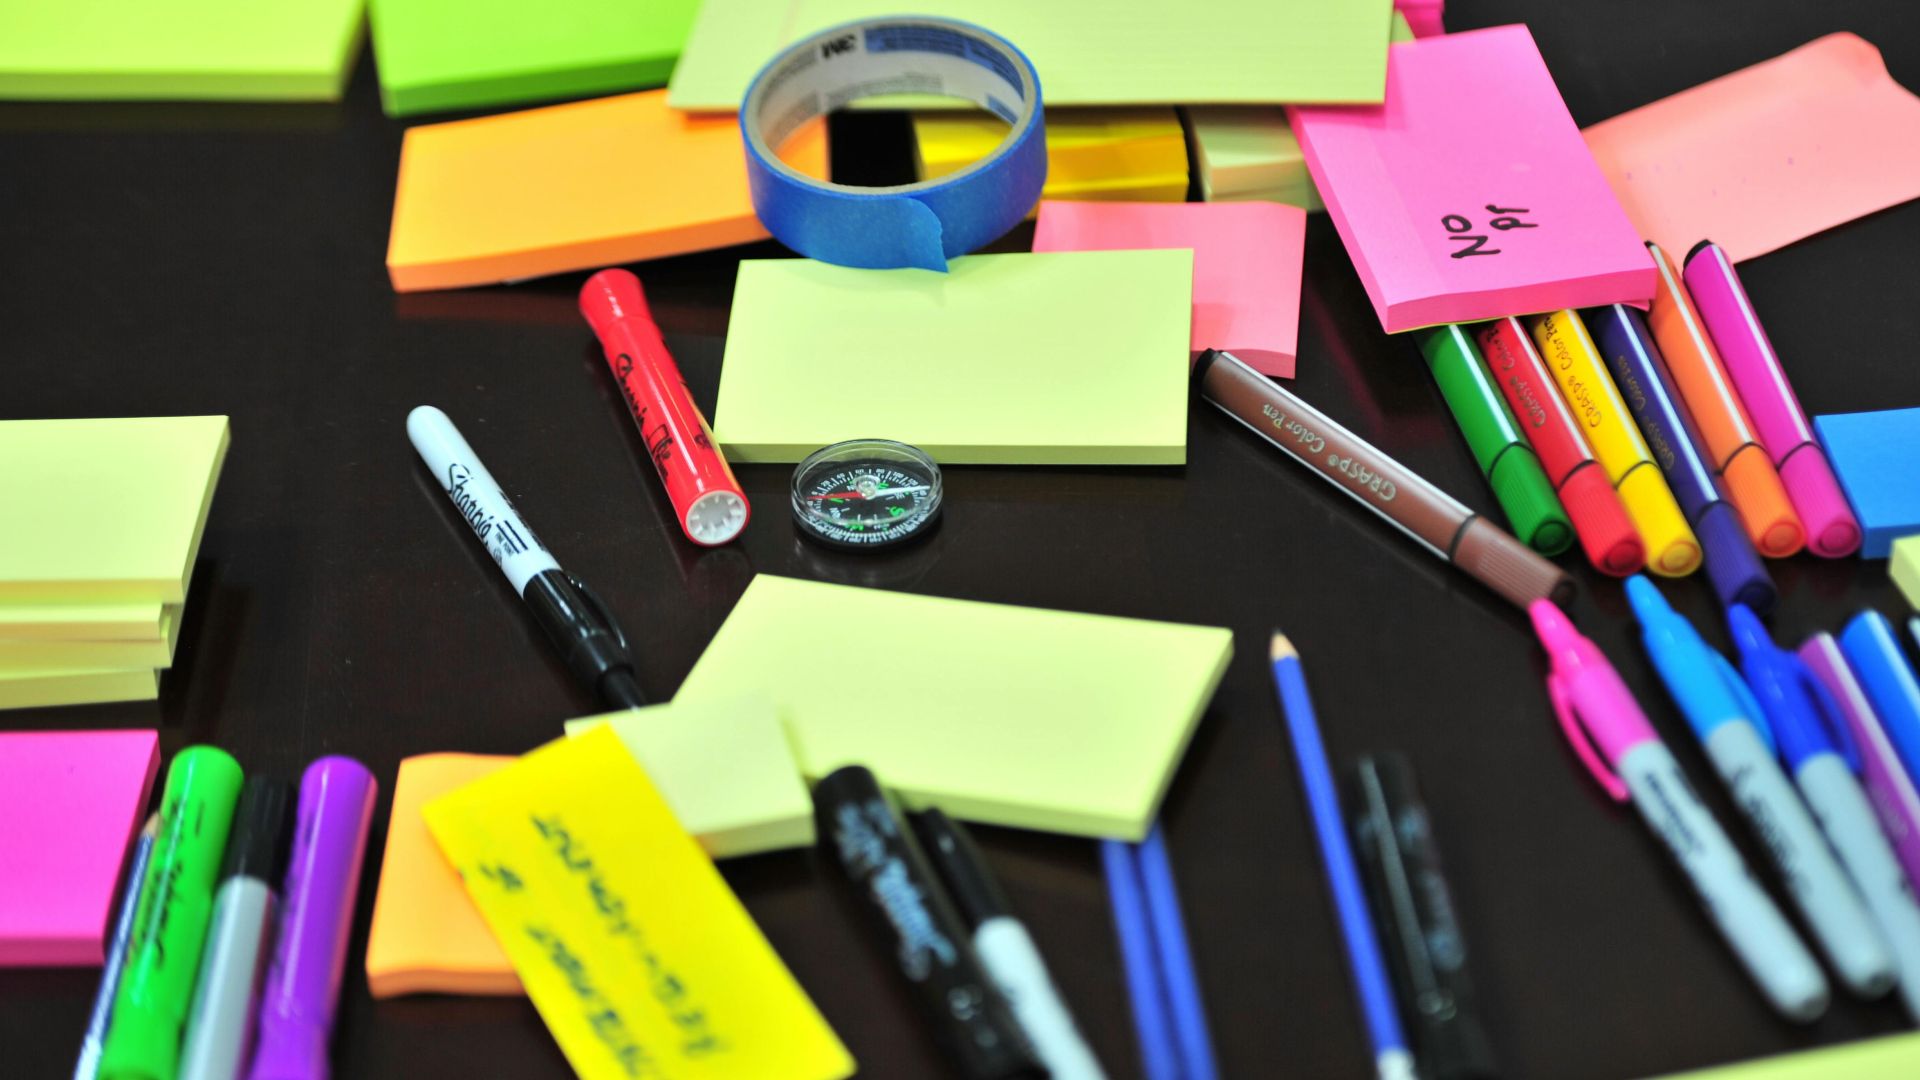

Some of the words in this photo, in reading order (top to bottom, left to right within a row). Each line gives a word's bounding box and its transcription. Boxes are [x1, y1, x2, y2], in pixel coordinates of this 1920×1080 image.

[821, 34, 857, 60] 3M
[1441, 214, 1501, 259] NO
[1262, 403, 1285, 429] Pen
[1286, 422, 1325, 454] Color
